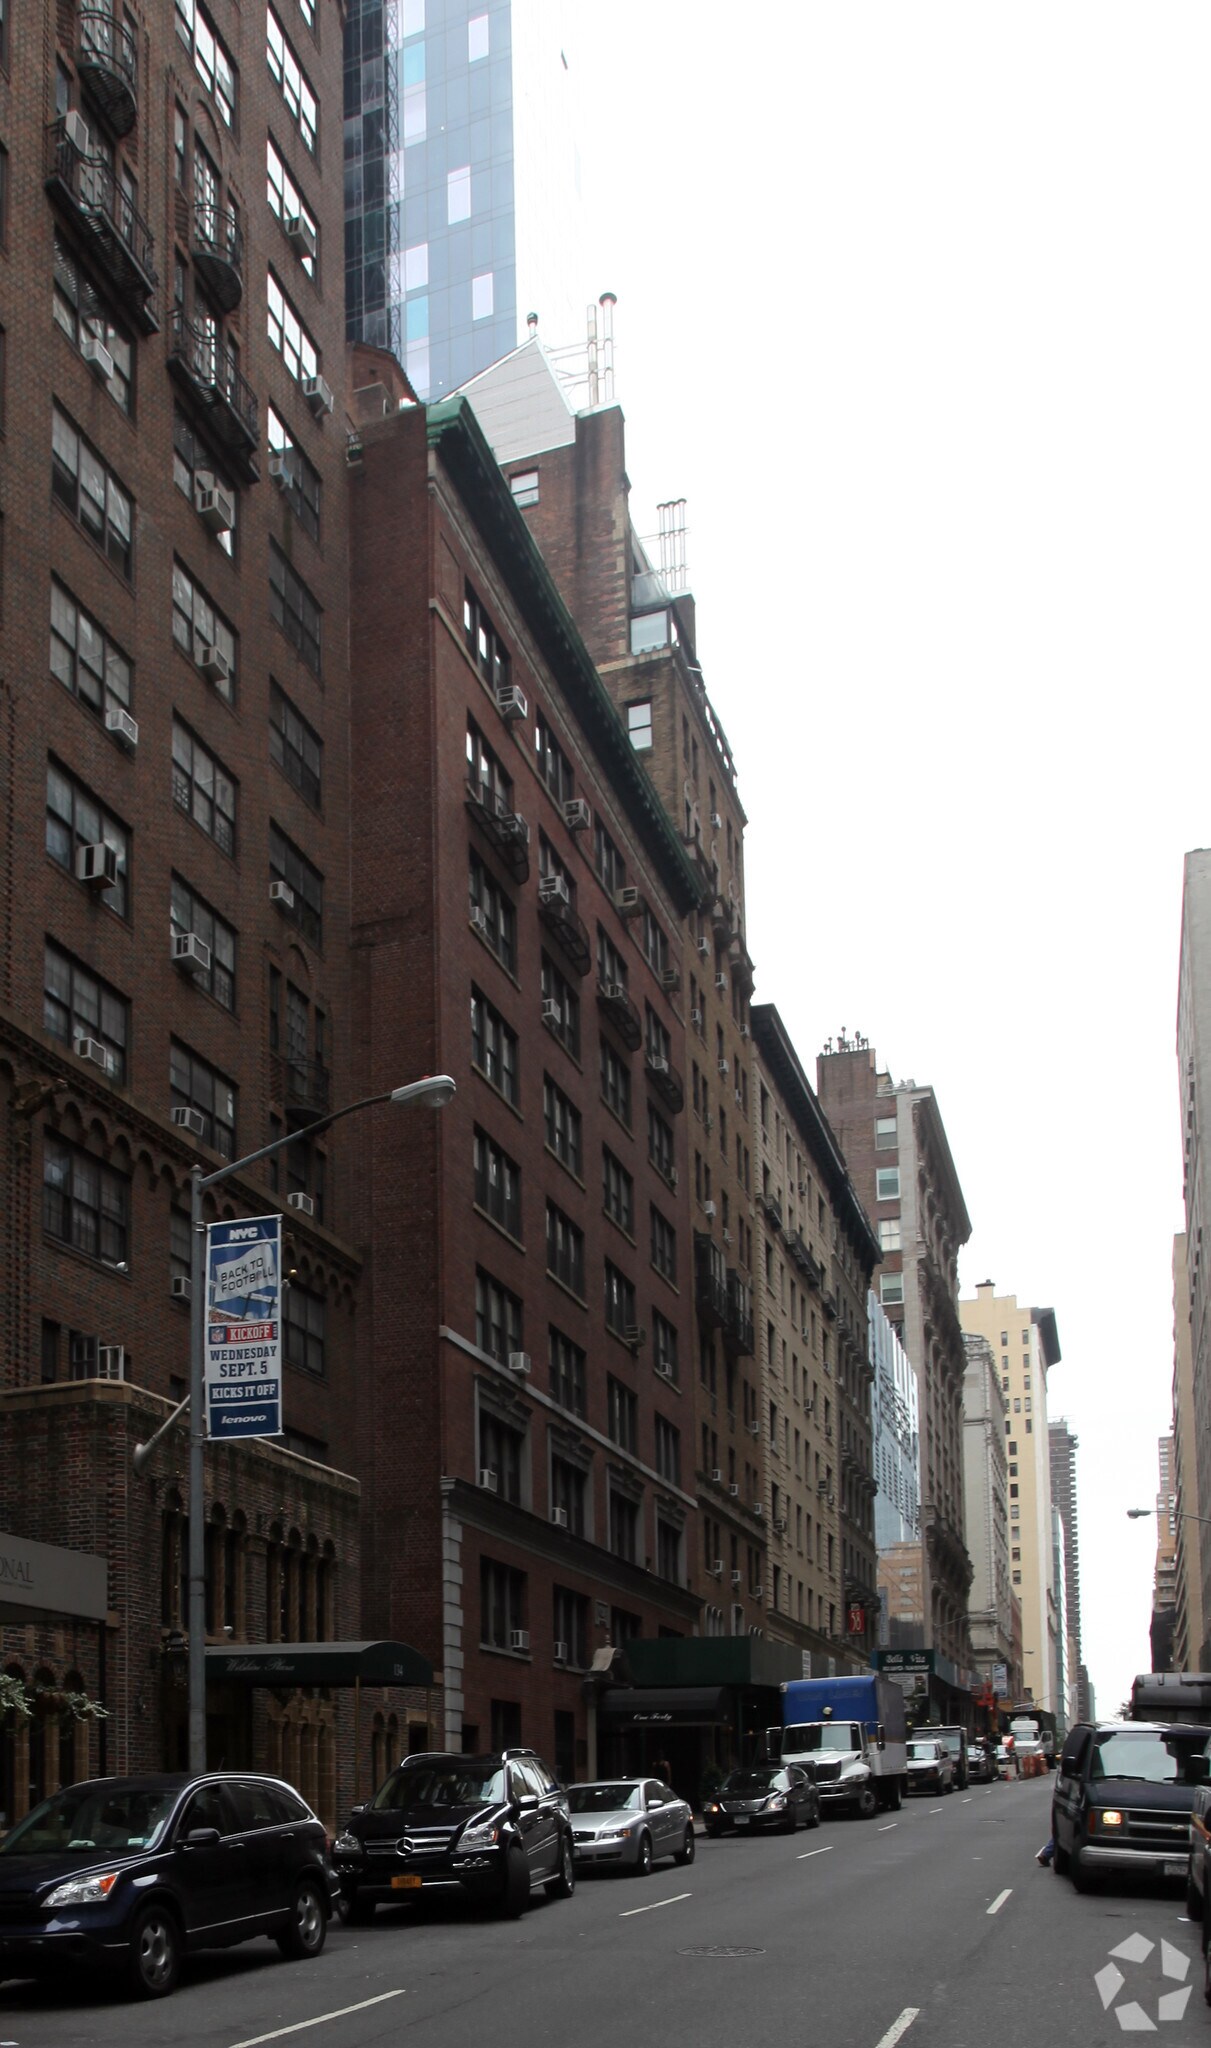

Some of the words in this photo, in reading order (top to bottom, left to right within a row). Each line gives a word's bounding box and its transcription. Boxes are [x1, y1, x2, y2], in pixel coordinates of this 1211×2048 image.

[229, 1226, 258, 1240] NYC
[220, 1265, 248, 1283] BACK
[249, 1257, 264, 1269] TO
[230, 1325, 270, 1341] KICKOFF
[210, 1346, 277, 1361] WEDNESDAY
[219, 1362, 257, 1377] SEPT.
[260, 1361, 268, 1375] 5
[212, 1387, 243, 1399] KICKS
[245, 1385, 256, 1397] IT
[257, 1383, 276, 1395] OFF
[221, 1414, 267, 1424] lenovo
